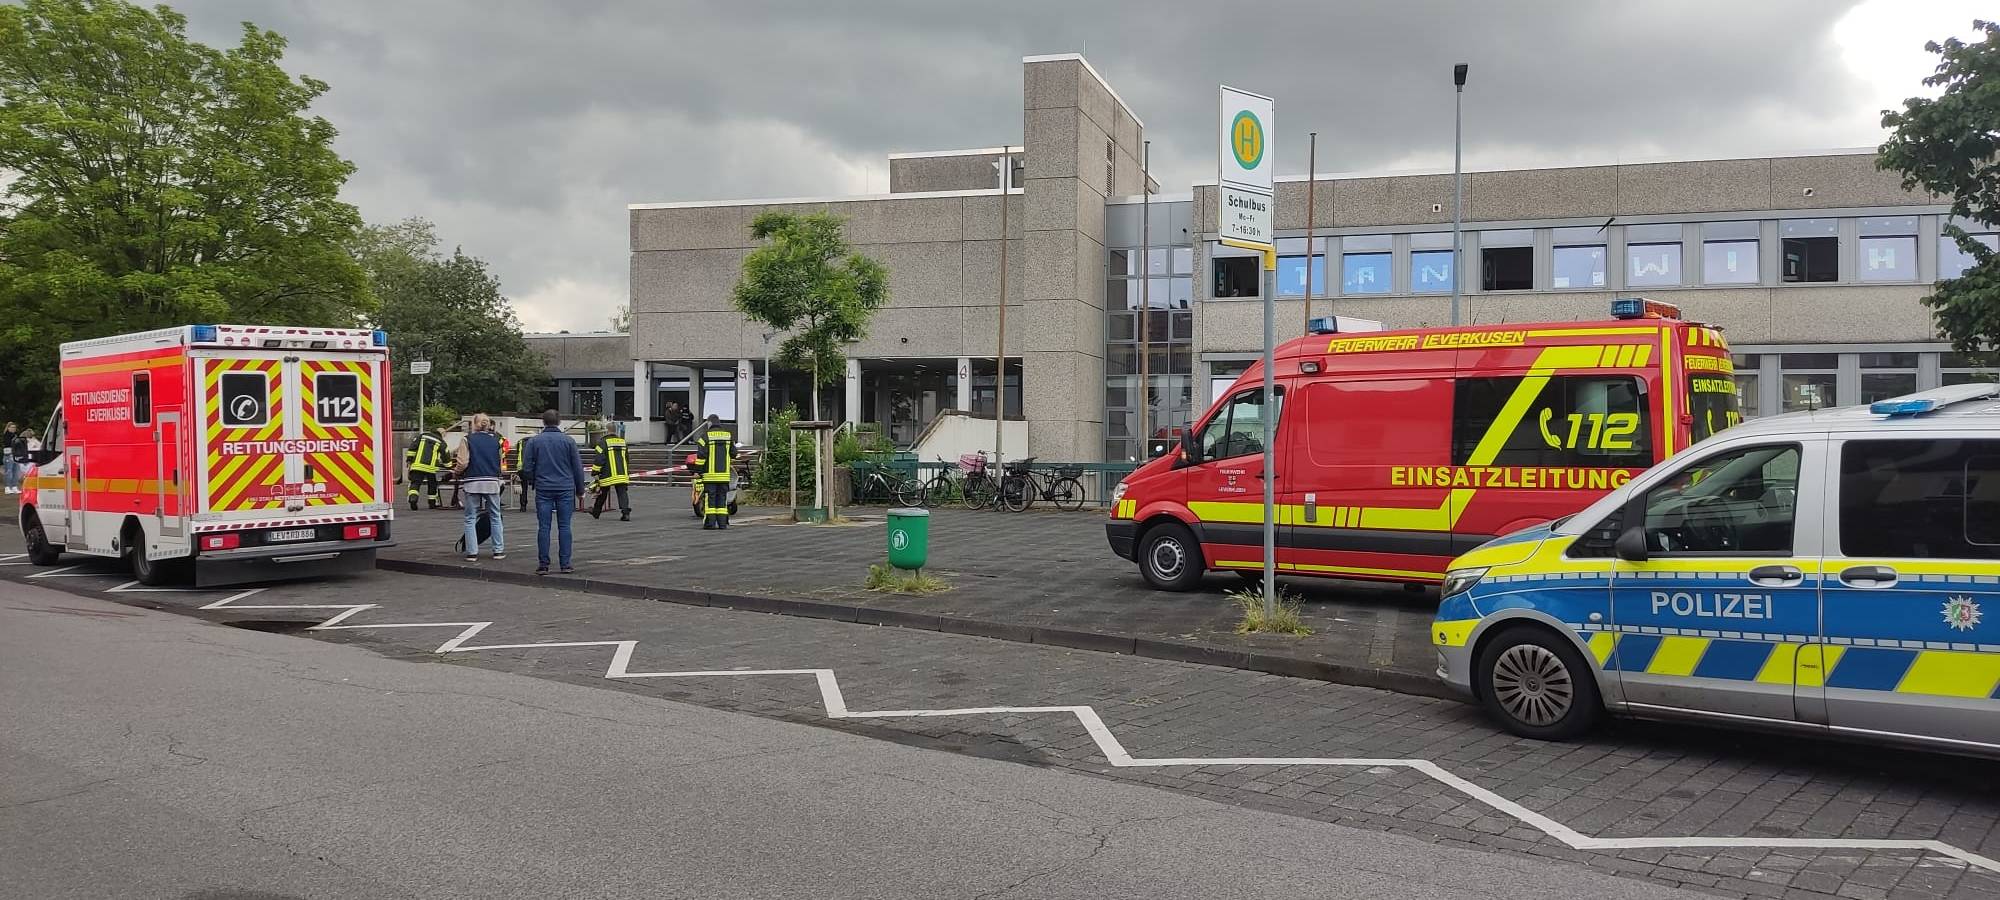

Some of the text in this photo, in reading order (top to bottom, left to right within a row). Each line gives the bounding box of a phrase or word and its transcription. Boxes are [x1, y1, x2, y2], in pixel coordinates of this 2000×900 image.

[1228, 194, 1266, 212] Schulbus
[1328, 331, 1527, 354] FEUERWEHR LEVERKUSEN
[71, 388, 130, 406] RETTUNGSDIENST
[318, 396, 357, 418] 112
[86, 406, 131, 422] LEVERKUSEN
[1566, 413, 1640, 449] 112
[222, 439, 360, 455] RETTUNGSDIENST
[1391, 466, 1631, 490] EINSATZLEITUNG
[1651, 591, 1773, 619] POLIZEI
